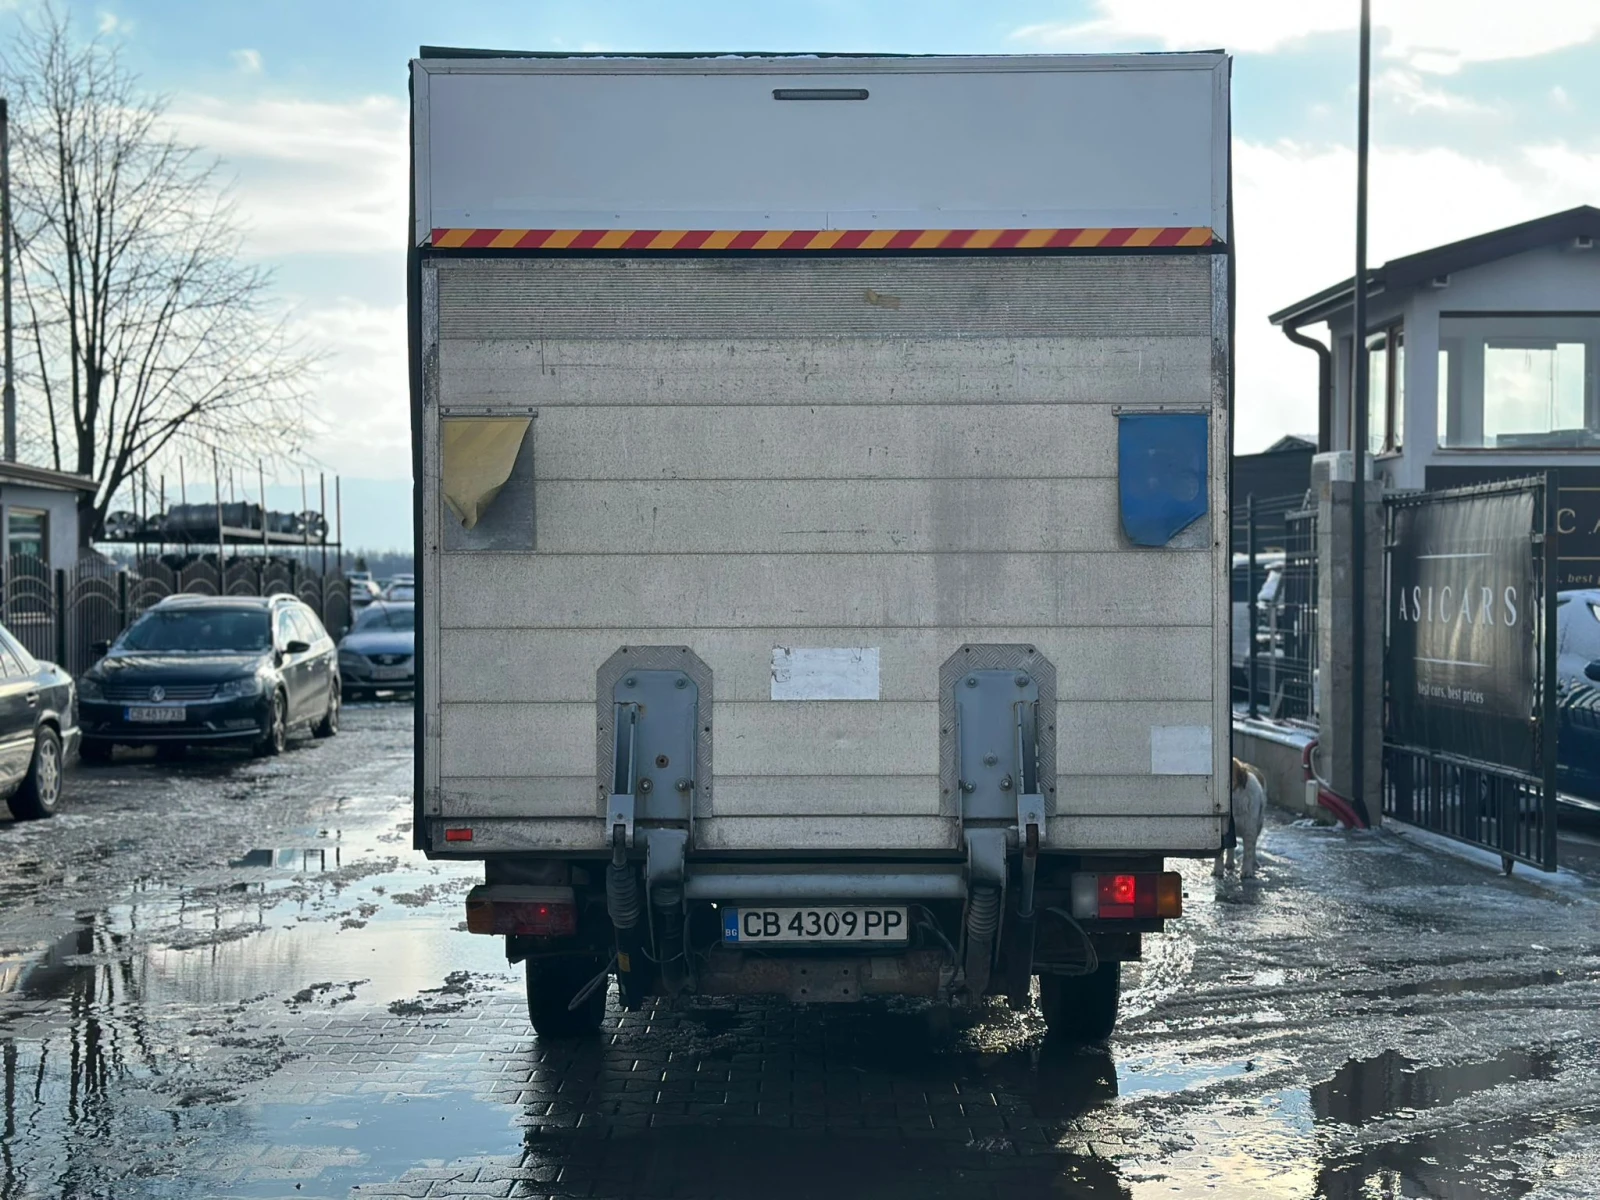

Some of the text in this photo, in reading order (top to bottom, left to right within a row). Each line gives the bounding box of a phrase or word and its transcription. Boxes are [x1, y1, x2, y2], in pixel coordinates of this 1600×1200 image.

[1557, 508, 1600, 534] C
[1400, 585, 1517, 626] ASICARS
[1447, 685, 1461, 700] best
[1463, 688, 1484, 704] prices
[725, 910, 902, 937] BG CB 4309 PP
